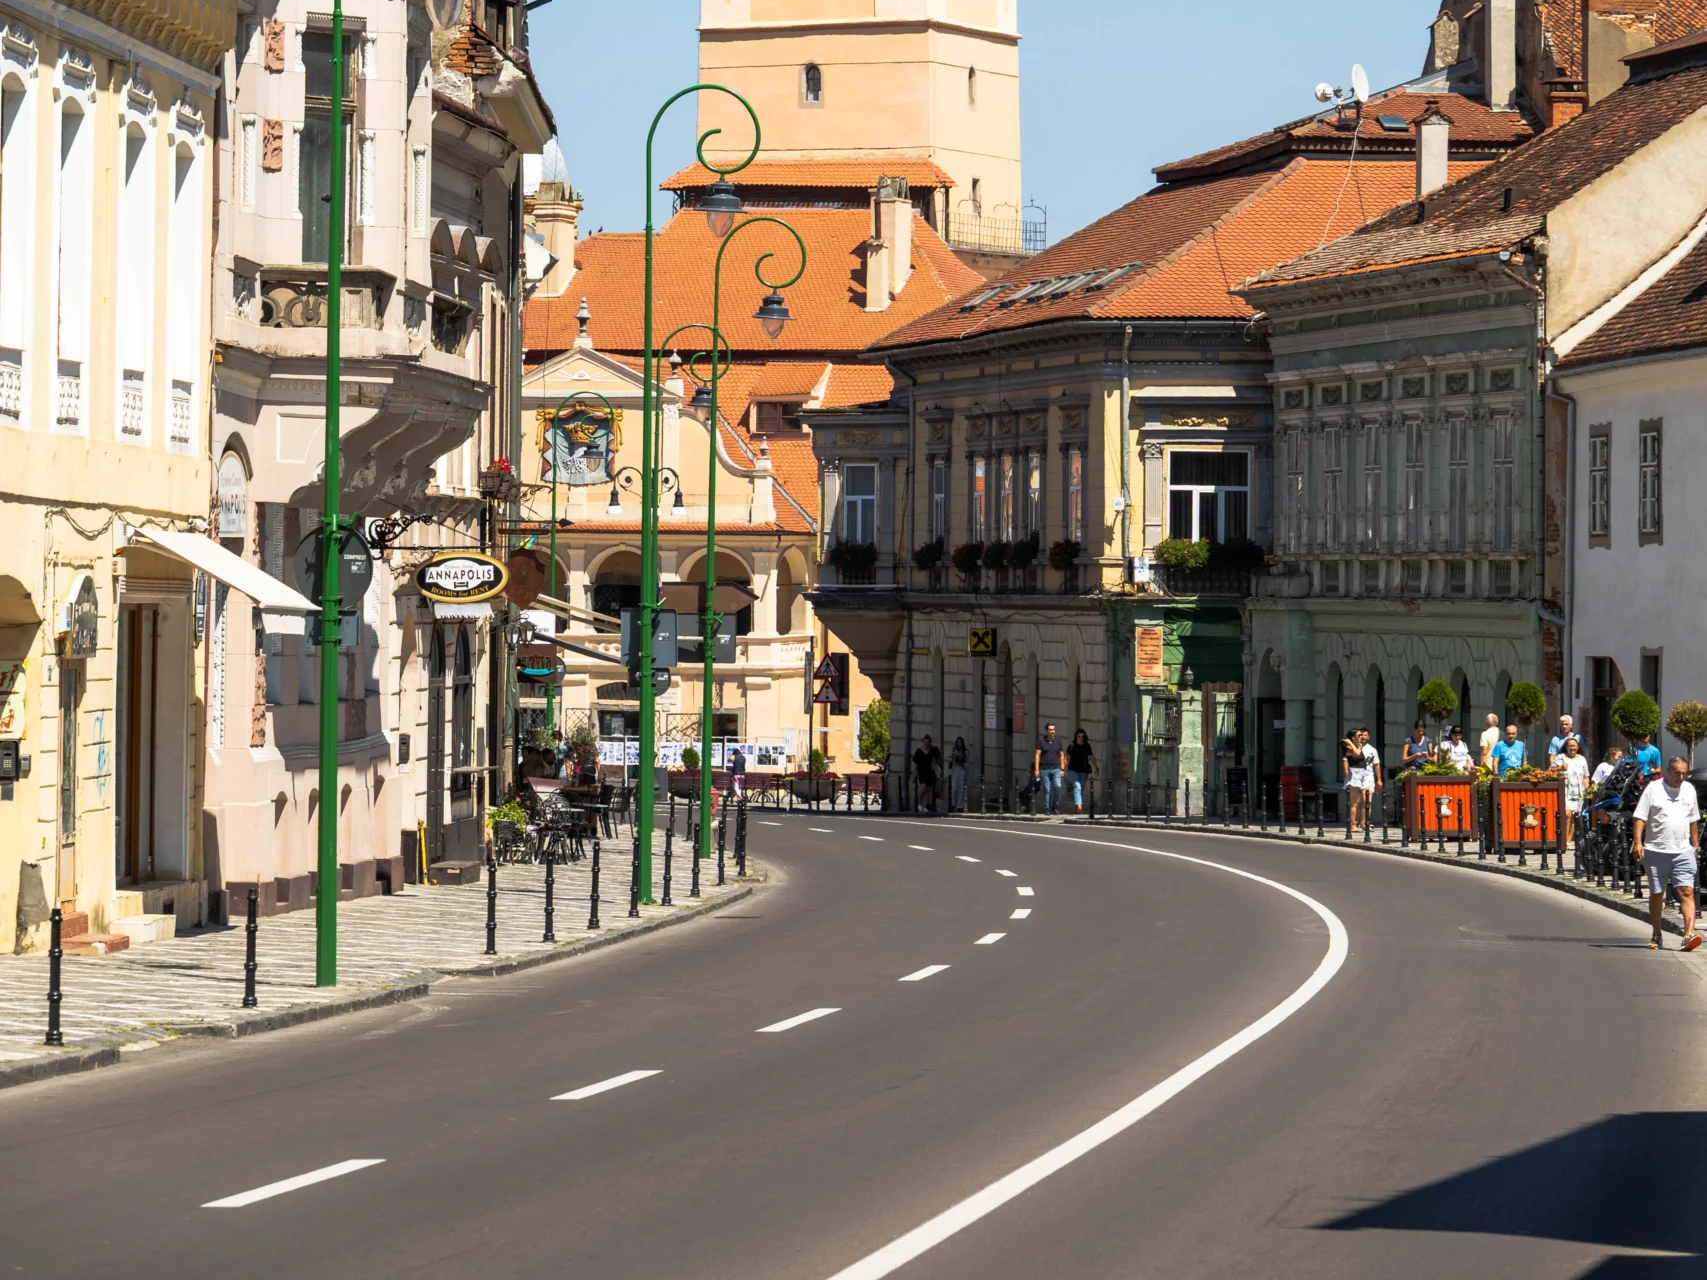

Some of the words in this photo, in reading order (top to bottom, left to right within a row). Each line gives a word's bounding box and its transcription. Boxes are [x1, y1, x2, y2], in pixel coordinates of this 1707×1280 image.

[427, 569, 492, 581] ANNAPOLIS
[430, 586, 457, 597] ROOMS
[470, 585, 490, 596] RENT
